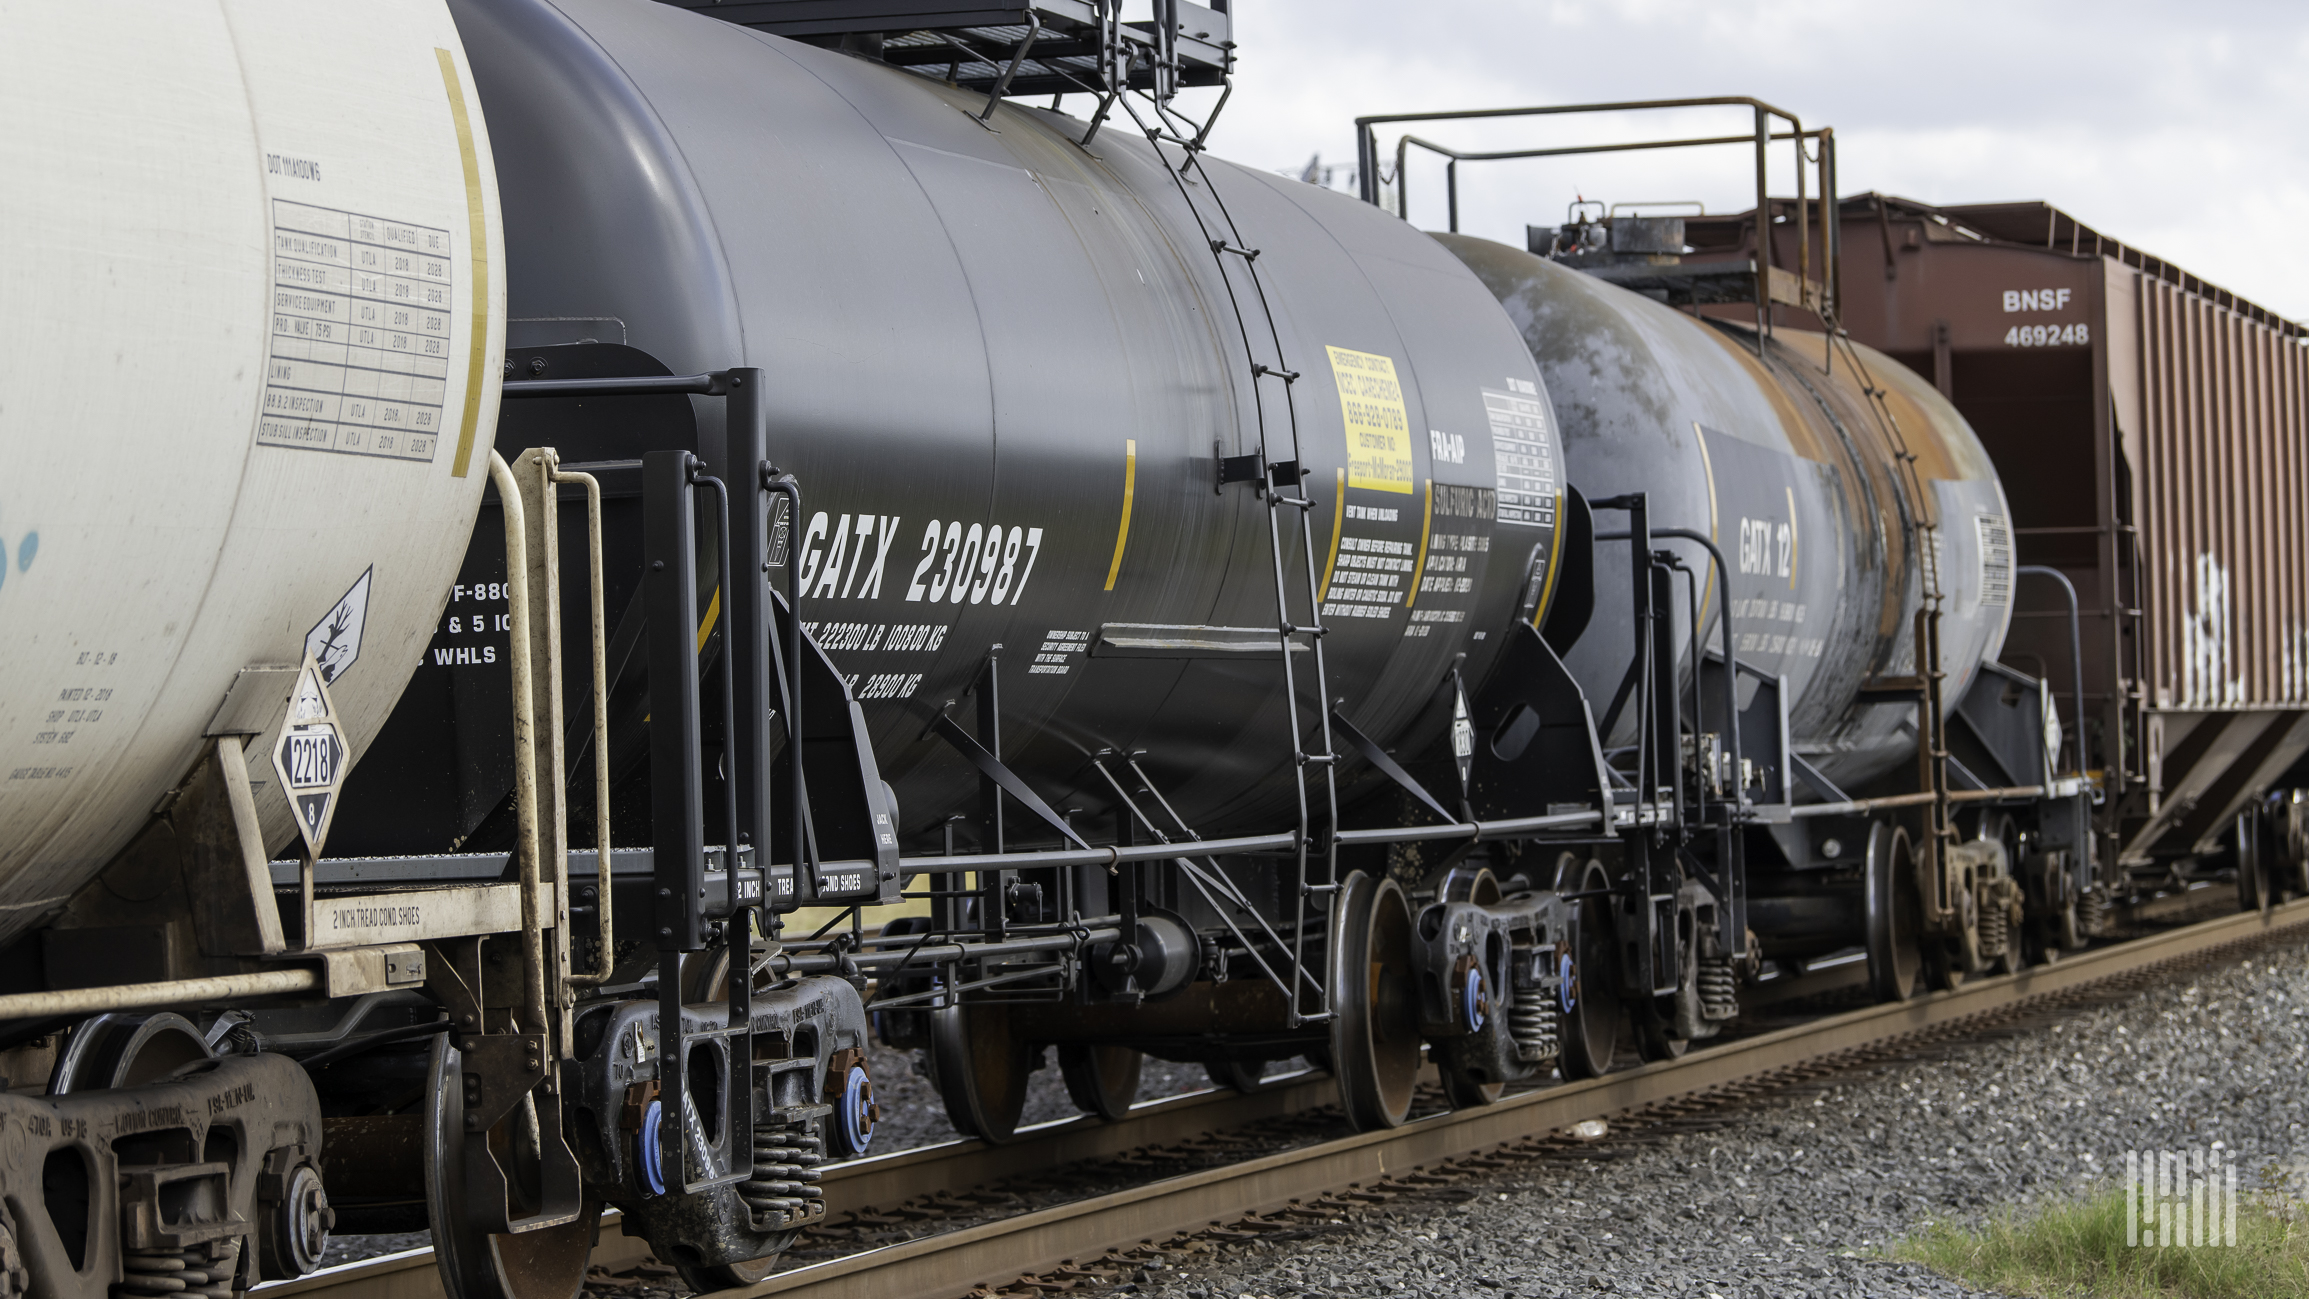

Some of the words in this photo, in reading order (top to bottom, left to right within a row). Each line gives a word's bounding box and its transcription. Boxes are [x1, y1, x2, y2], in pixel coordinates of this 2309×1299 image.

[267, 154, 282, 175] DOT
[386, 226, 415, 245] QUALIFIED
[428, 234, 439, 249] DUE
[277, 236, 292, 250] TANK
[293, 238, 337, 258] QUALIFICATION
[362, 252, 376, 266] UTLA
[395, 257, 408, 271] 2018
[428, 262, 442, 277] 2028
[278, 264, 310, 282] THICKNESS
[312, 270, 326, 284] TEST
[362, 278, 376, 292] UTLA
[395, 284, 408, 298] 2018
[428, 289, 442, 303] 2028
[277, 293, 302, 310] SERVICE
[304, 296, 336, 314] EQUIPMENT
[361, 306, 376, 321] UTLA
[394, 312, 408, 326] 2018
[426, 316, 442, 331] 2028
[2003, 288, 2072, 312] BNSF
[294, 320, 310, 336] VALVE
[360, 330, 374, 344] UTLA
[393, 335, 407, 349] 2018
[425, 340, 440, 354] 2028
[2004, 324, 2089, 347] 469248
[270, 366, 291, 380] LINING
[288, 396, 324, 414] INSPECTION
[350, 404, 366, 418] UTLA
[384, 408, 399, 422] 2018
[416, 412, 432, 426] 2028
[1347, 401, 1404, 431] 866-928-0789
[261, 423, 278, 438] STUB
[278, 424, 291, 440] SILL
[291, 426, 328, 443] INSPECTION
[345, 432, 360, 446] UTLA
[378, 436, 394, 450] 2018
[410, 439, 426, 453] 2028
[1359, 432, 1386, 450] CUSTOMER
[1434, 484, 1475, 518] SULFURIC
[1476, 488, 1496, 520] ACID
[799, 512, 900, 600] GATX
[905, 519, 1043, 606] 230987
[1739, 516, 1772, 576] GATX
[1776, 522, 1791, 578] 12
[472, 615, 484, 632] 5
[818, 622, 868, 650] 222300
[862, 624, 886, 651] LB
[882, 624, 931, 652] 100800
[924, 625, 948, 652] KG
[434, 646, 496, 666] WHLS
[858, 674, 906, 699] 28900
[898, 674, 923, 699] KG
[294, 736, 330, 784] 2218
[308, 803, 316, 826] 8
[876, 814, 888, 825] JACK
[880, 833, 892, 844] HERE
[744, 880, 760, 899] INCH
[778, 878, 794, 896] TREA
[840, 874, 861, 892] SHOES
[333, 910, 338, 930] 2
[340, 909, 356, 929] INCH
[356, 908, 378, 928] TREAD
[398, 906, 420, 926] SHOES
